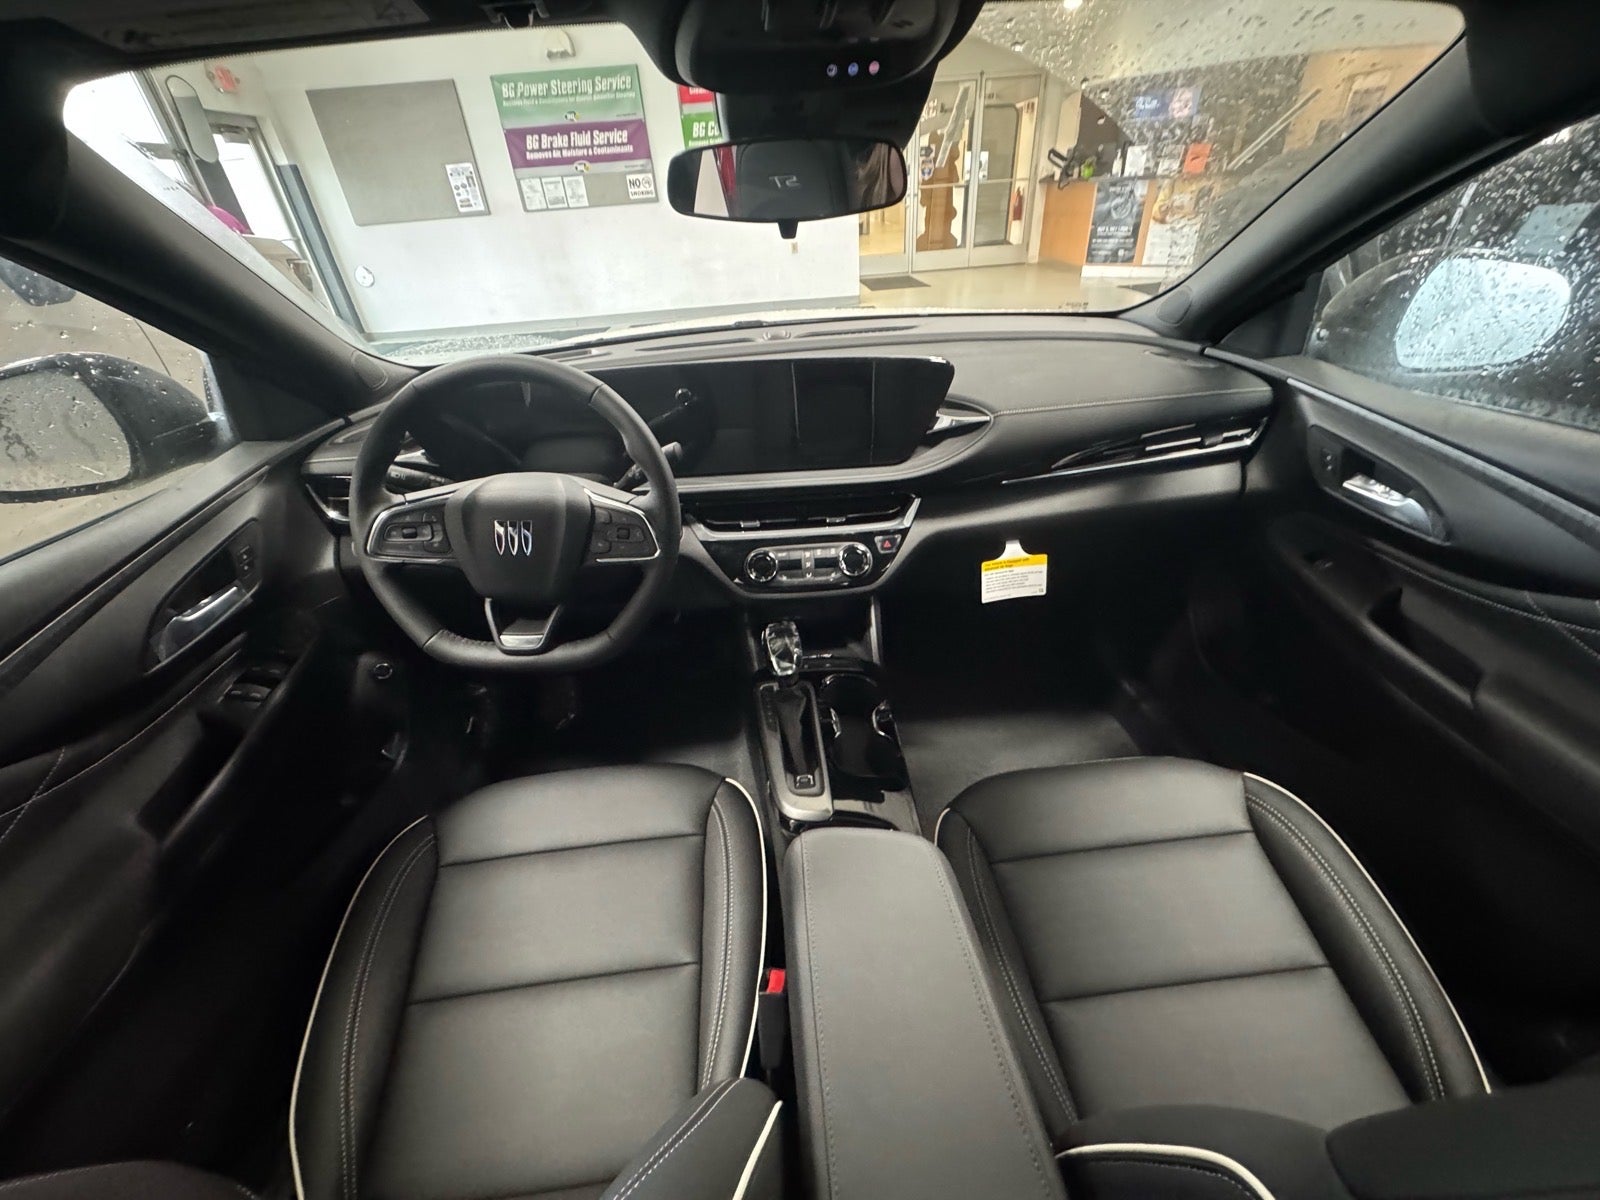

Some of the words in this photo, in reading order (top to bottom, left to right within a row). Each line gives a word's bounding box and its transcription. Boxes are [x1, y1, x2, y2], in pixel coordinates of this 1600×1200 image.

[502, 82, 515, 98] BG
[517, 81, 548, 97] Power
[551, 77, 593, 96] Steering
[595, 74, 631, 92] Service
[693, 121, 706, 138] BG
[526, 134, 539, 150] BG
[541, 132, 568, 149] Brake
[570, 130, 591, 147] Fluid
[593, 128, 628, 145] Service
[526, 149, 552, 160] Removes
[562, 147, 588, 158] Moisture
[593, 144, 634, 155] Contaminants
[629, 178, 641, 189] NO
[630, 189, 654, 197] SMOKING
